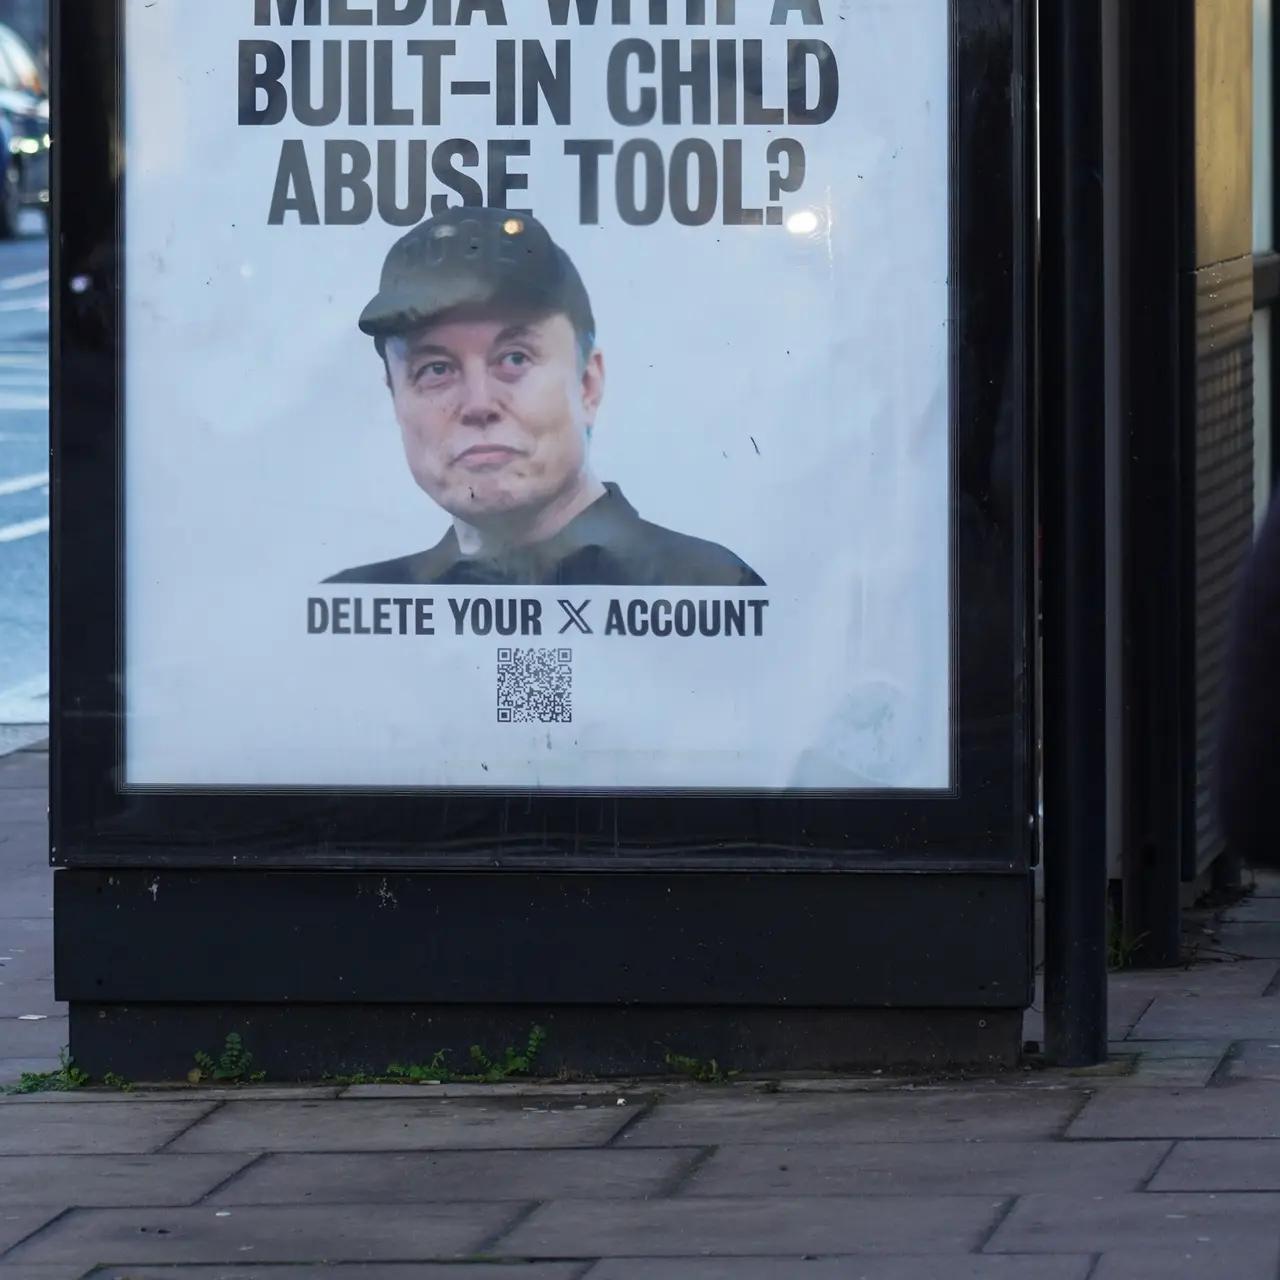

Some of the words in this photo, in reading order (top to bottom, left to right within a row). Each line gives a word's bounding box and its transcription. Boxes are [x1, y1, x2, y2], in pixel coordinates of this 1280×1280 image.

[237, 39, 571, 127] BUILT-IN
[606, 38, 840, 126] CHILD
[267, 138, 533, 226] ABUSE
[564, 138, 806, 227] TOOL?
[307, 597, 435, 635] DELETE
[447, 598, 543, 636] YOUR
[604, 599, 770, 637] ACCOUNT
